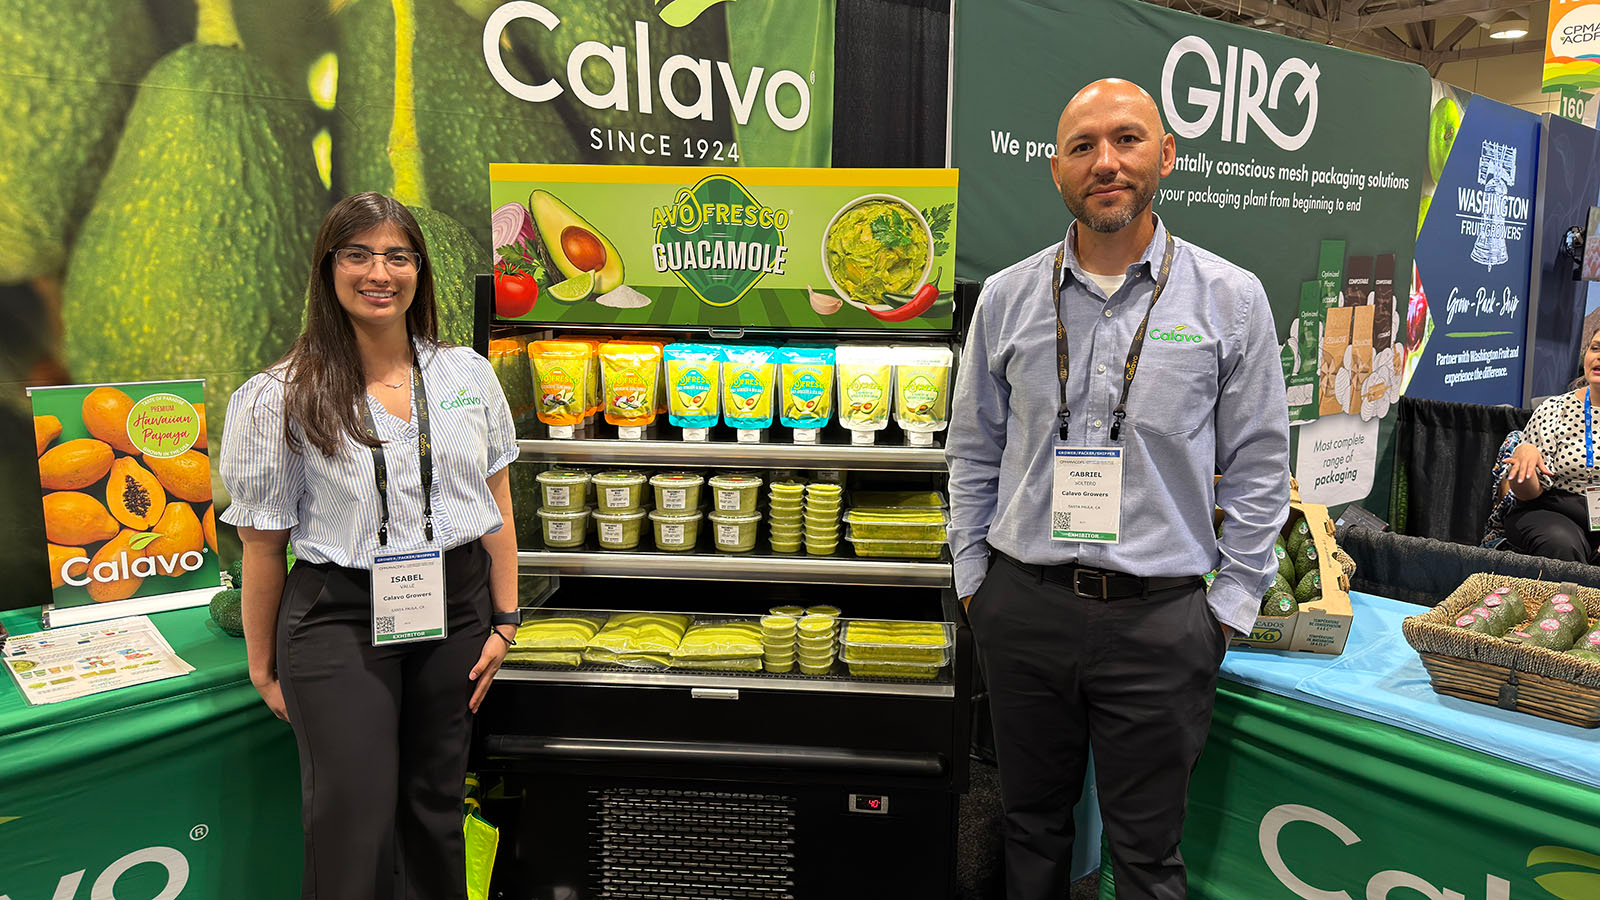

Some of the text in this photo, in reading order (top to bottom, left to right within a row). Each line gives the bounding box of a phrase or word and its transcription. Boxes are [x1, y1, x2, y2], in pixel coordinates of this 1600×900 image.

[482, 1, 812, 131] Calavo
[1161, 36, 1320, 151] GIRO
[590, 128, 740, 162] SINCE 1924
[990, 130, 1410, 191] We pro ntally conscious mesh packaging solutions
[1159, 188, 1185, 205] your
[1187, 185, 1241, 210] packaging
[1243, 188, 1268, 210] plant
[1270, 190, 1291, 208] from
[1292, 192, 1334, 215] beginning
[1336, 198, 1345, 211] to
[1346, 196, 1362, 212] end
[1457, 187, 1529, 220] WASHINGTON
[1461, 219, 1484, 237] FRUIT
[652, 240, 789, 275] GUACAMOLE
[1149, 328, 1203, 343] Calavo
[1436, 345, 1519, 366] Partner with Washington Fruit and
[1126, 355, 1139, 381] Calavo
[1444, 369, 1473, 387] experience
[1473, 367, 1482, 380] the
[440, 396, 481, 411] Calavo
[132, 411, 193, 429] Hawaiian
[142, 427, 190, 447] Papaya
[1313, 432, 1365, 453] Most complete
[1323, 449, 1354, 469] range of
[1314, 468, 1358, 490] packaging
[61, 550, 204, 587] Calavo
[391, 573, 424, 584] ISABEL
[383, 591, 432, 602] Calavo Growers
[1254, 620, 1285, 629] CADOS
